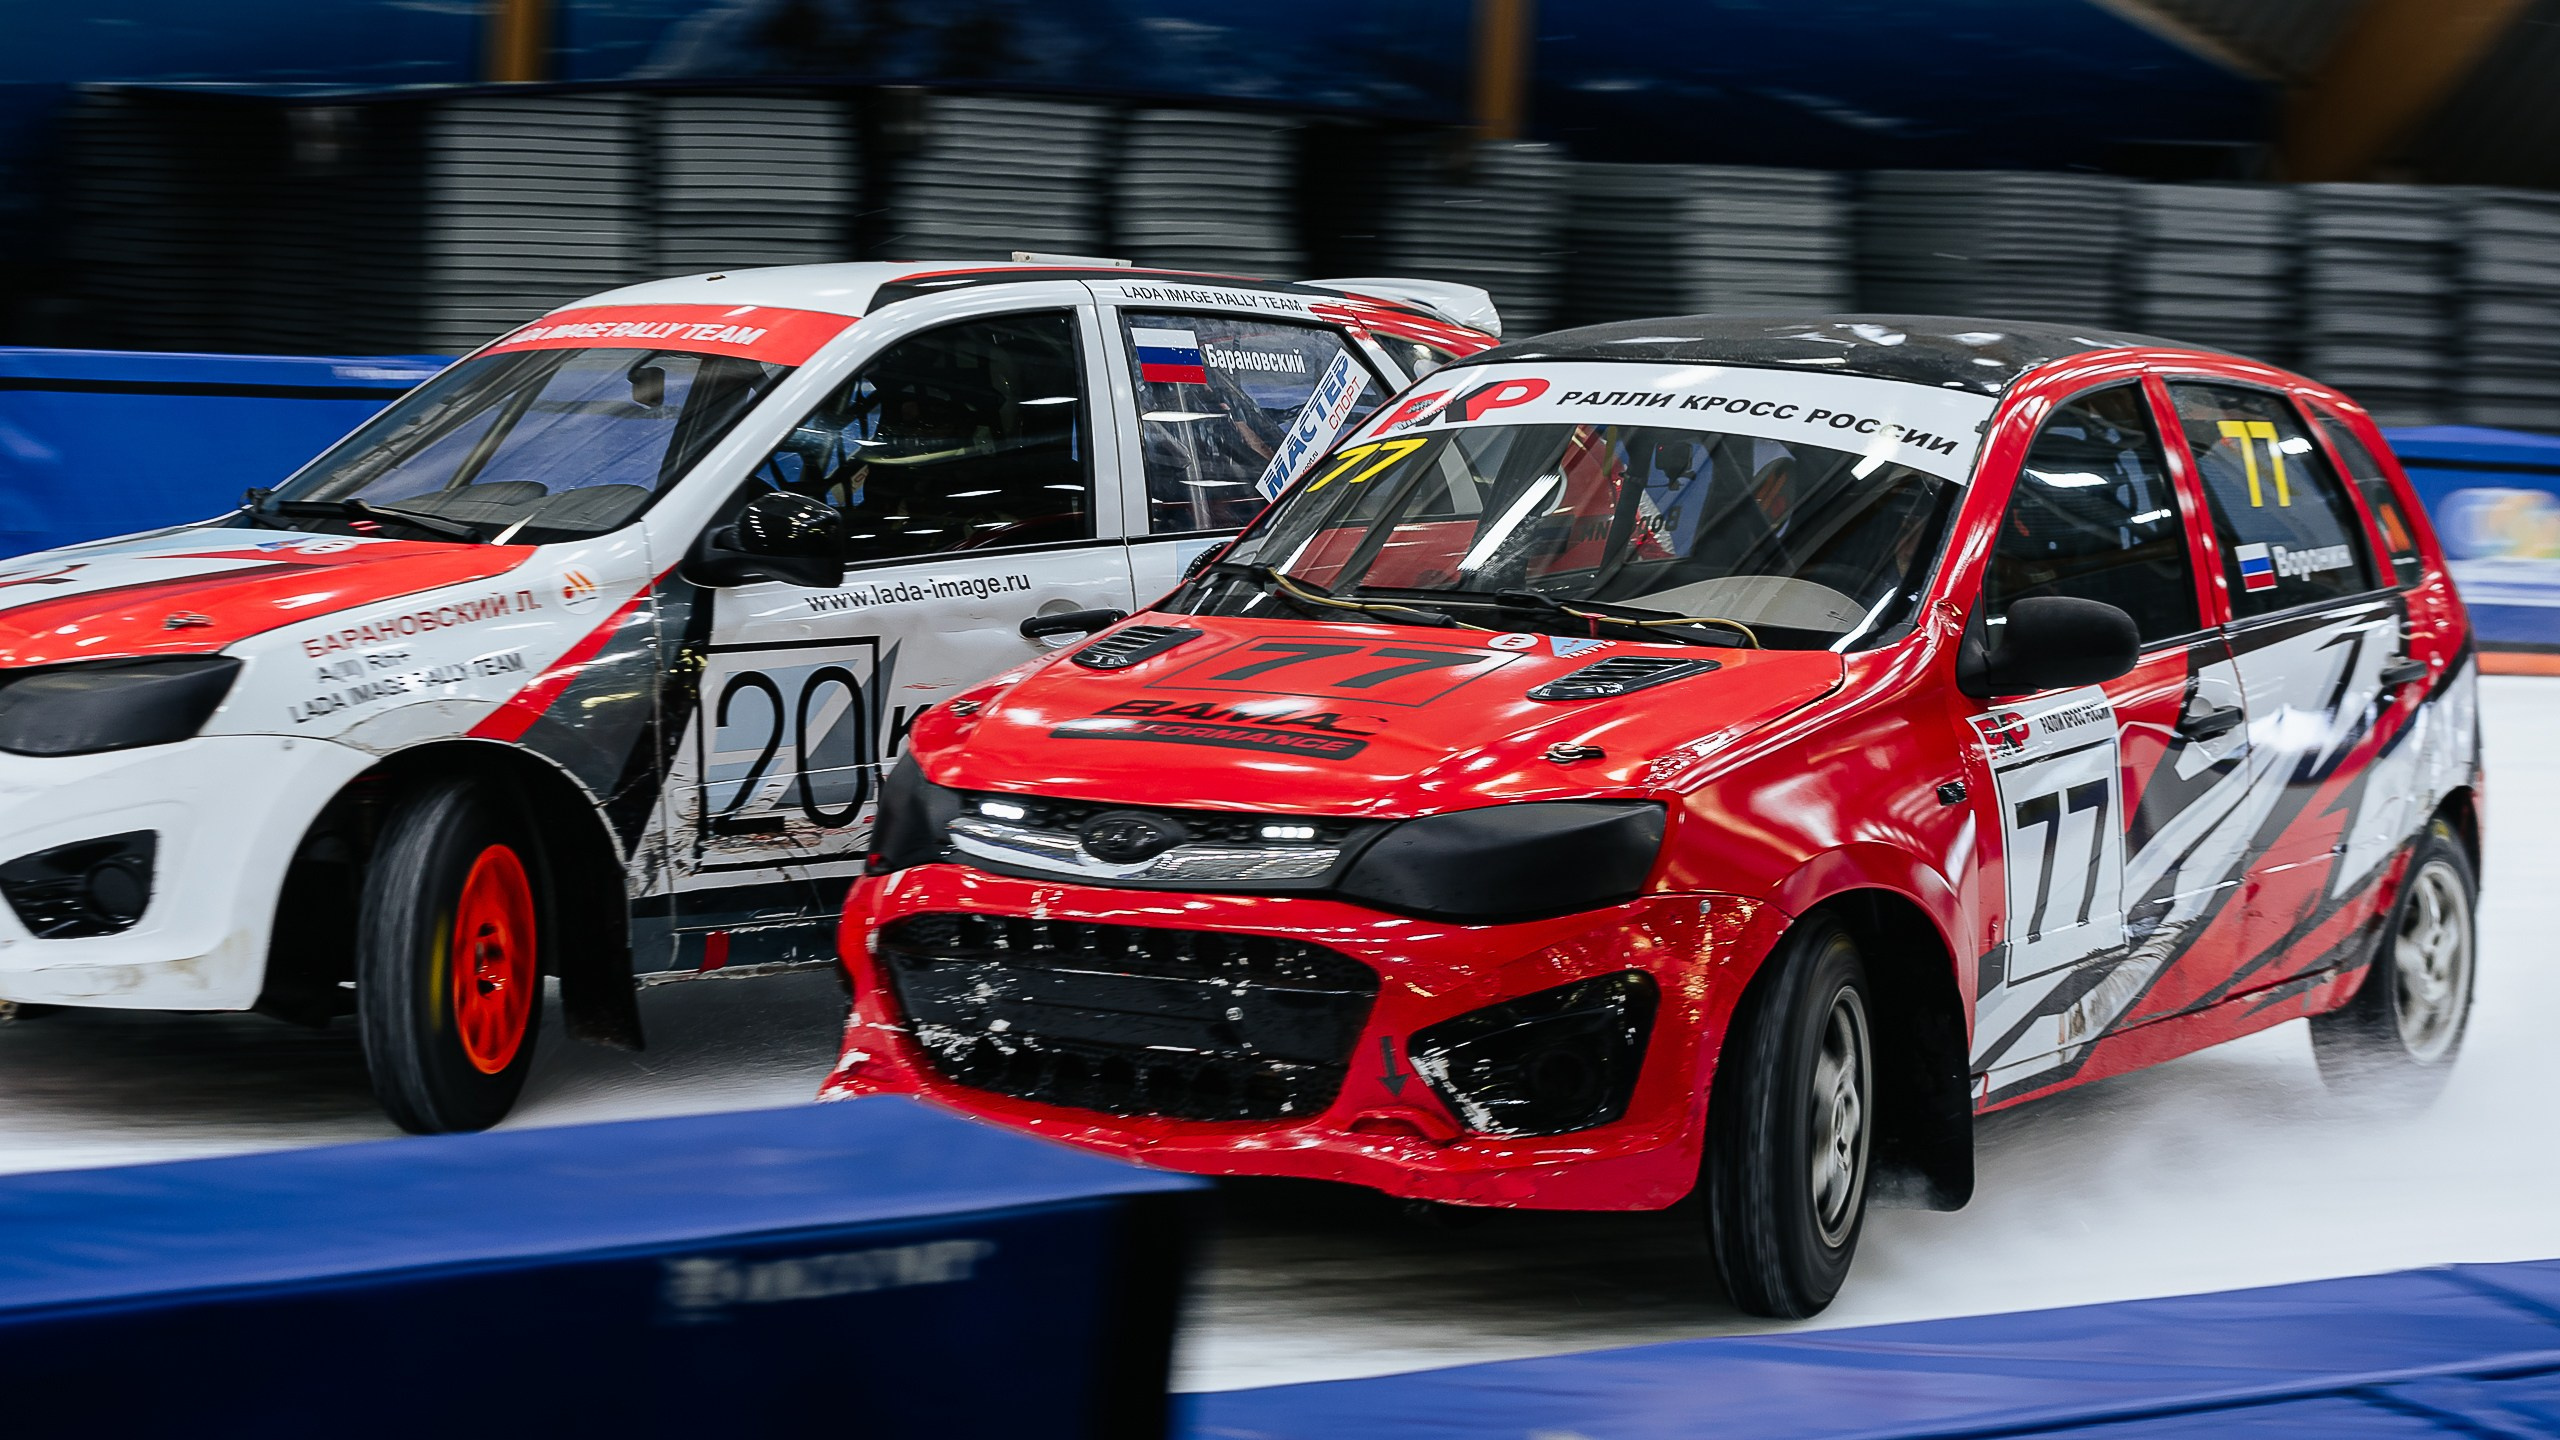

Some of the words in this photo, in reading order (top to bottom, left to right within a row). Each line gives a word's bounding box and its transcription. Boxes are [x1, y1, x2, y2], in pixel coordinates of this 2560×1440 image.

[1121, 286, 1164, 300] LADA
[1163, 289, 1212, 304] IMAGE
[1213, 292, 1260, 308] RALLY
[1259, 296, 1303, 311] TEAM
[601, 321, 690, 339] RALLY
[680, 323, 767, 345] TEAM
[1205, 343, 1307, 375] Барановский
[1264, 355, 1349, 500] МАСТЕР
[1328, 376, 1361, 430] СПОРТ
[1556, 390, 1675, 408] РАЛЛИ
[1679, 394, 1799, 420] КРОСС
[1804, 408, 1959, 456] РОССИИ
[1305, 437, 1429, 493] 77
[2216, 420, 2291, 508] 77
[804, 574, 1032, 612] www.lada-image.ru
[302, 593, 510, 658] БАРАНОВСКИЙ
[1209, 643, 1486, 688] 77
[289, 692, 347, 724] LADA
[714, 666, 869, 836] 20
[2014, 777, 2109, 944] 77
